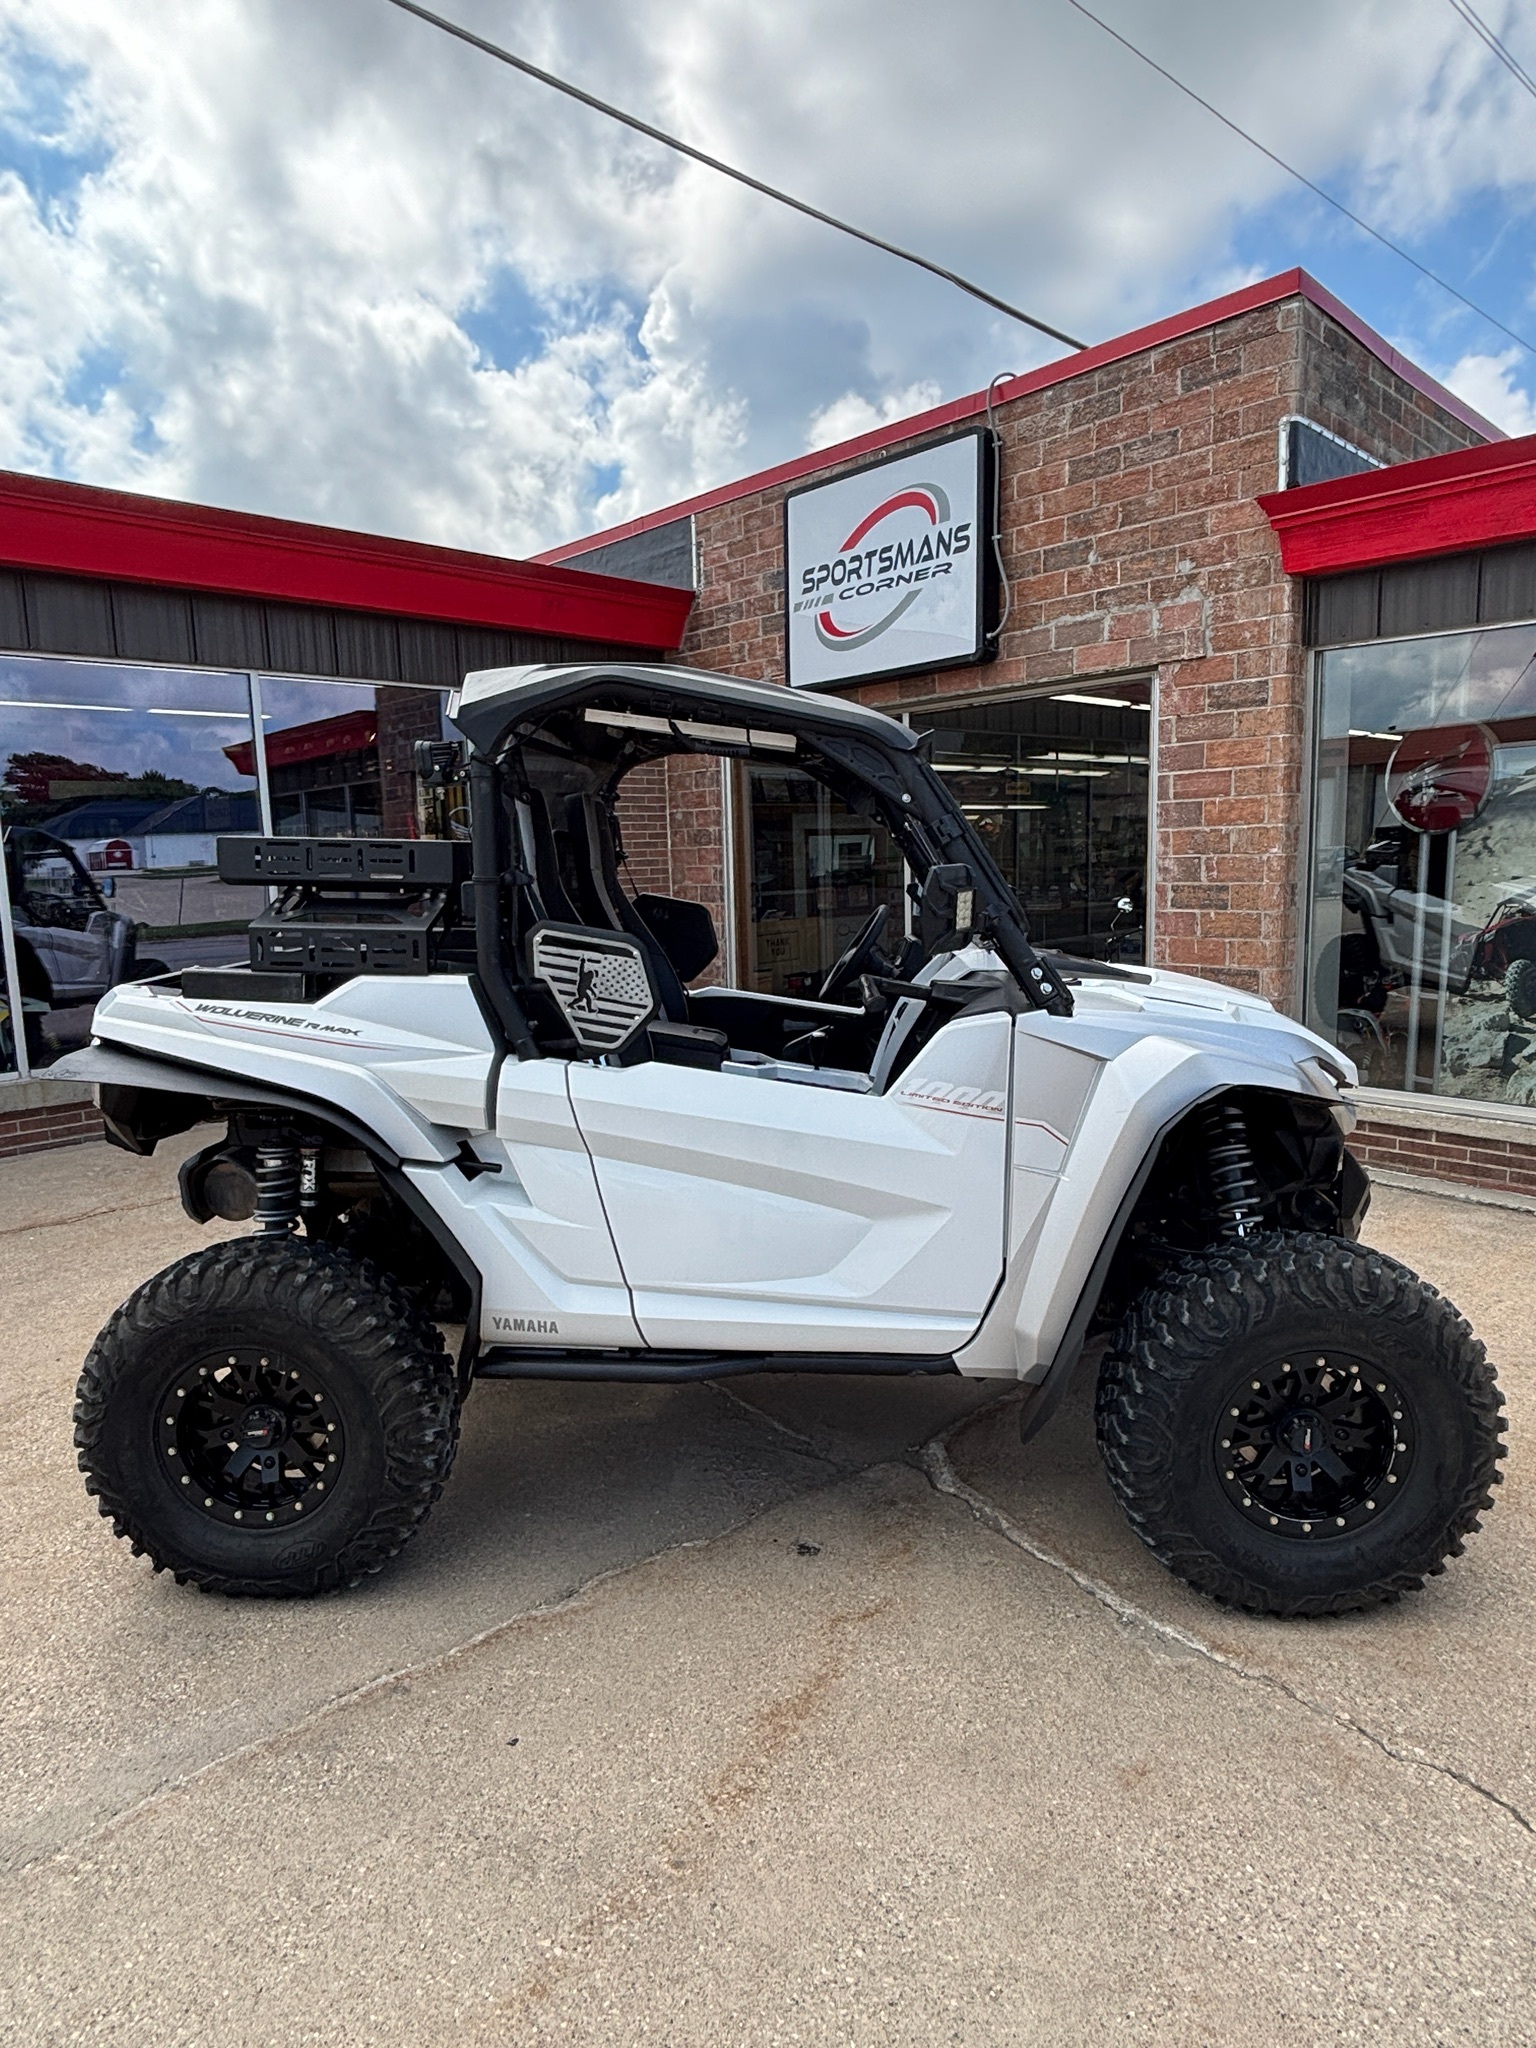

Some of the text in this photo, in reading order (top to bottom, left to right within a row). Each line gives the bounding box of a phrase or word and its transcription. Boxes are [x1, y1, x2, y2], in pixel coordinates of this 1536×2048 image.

[801, 522, 972, 596] SPORTSMANS
[838, 562, 953, 600] CORNER
[195, 1003, 307, 1027] WOLVERINE
[900, 1091, 1003, 1112] LIMITED EDITION
[302, 1159, 316, 1192] FOX
[492, 1316, 559, 1334] YAMAHA
